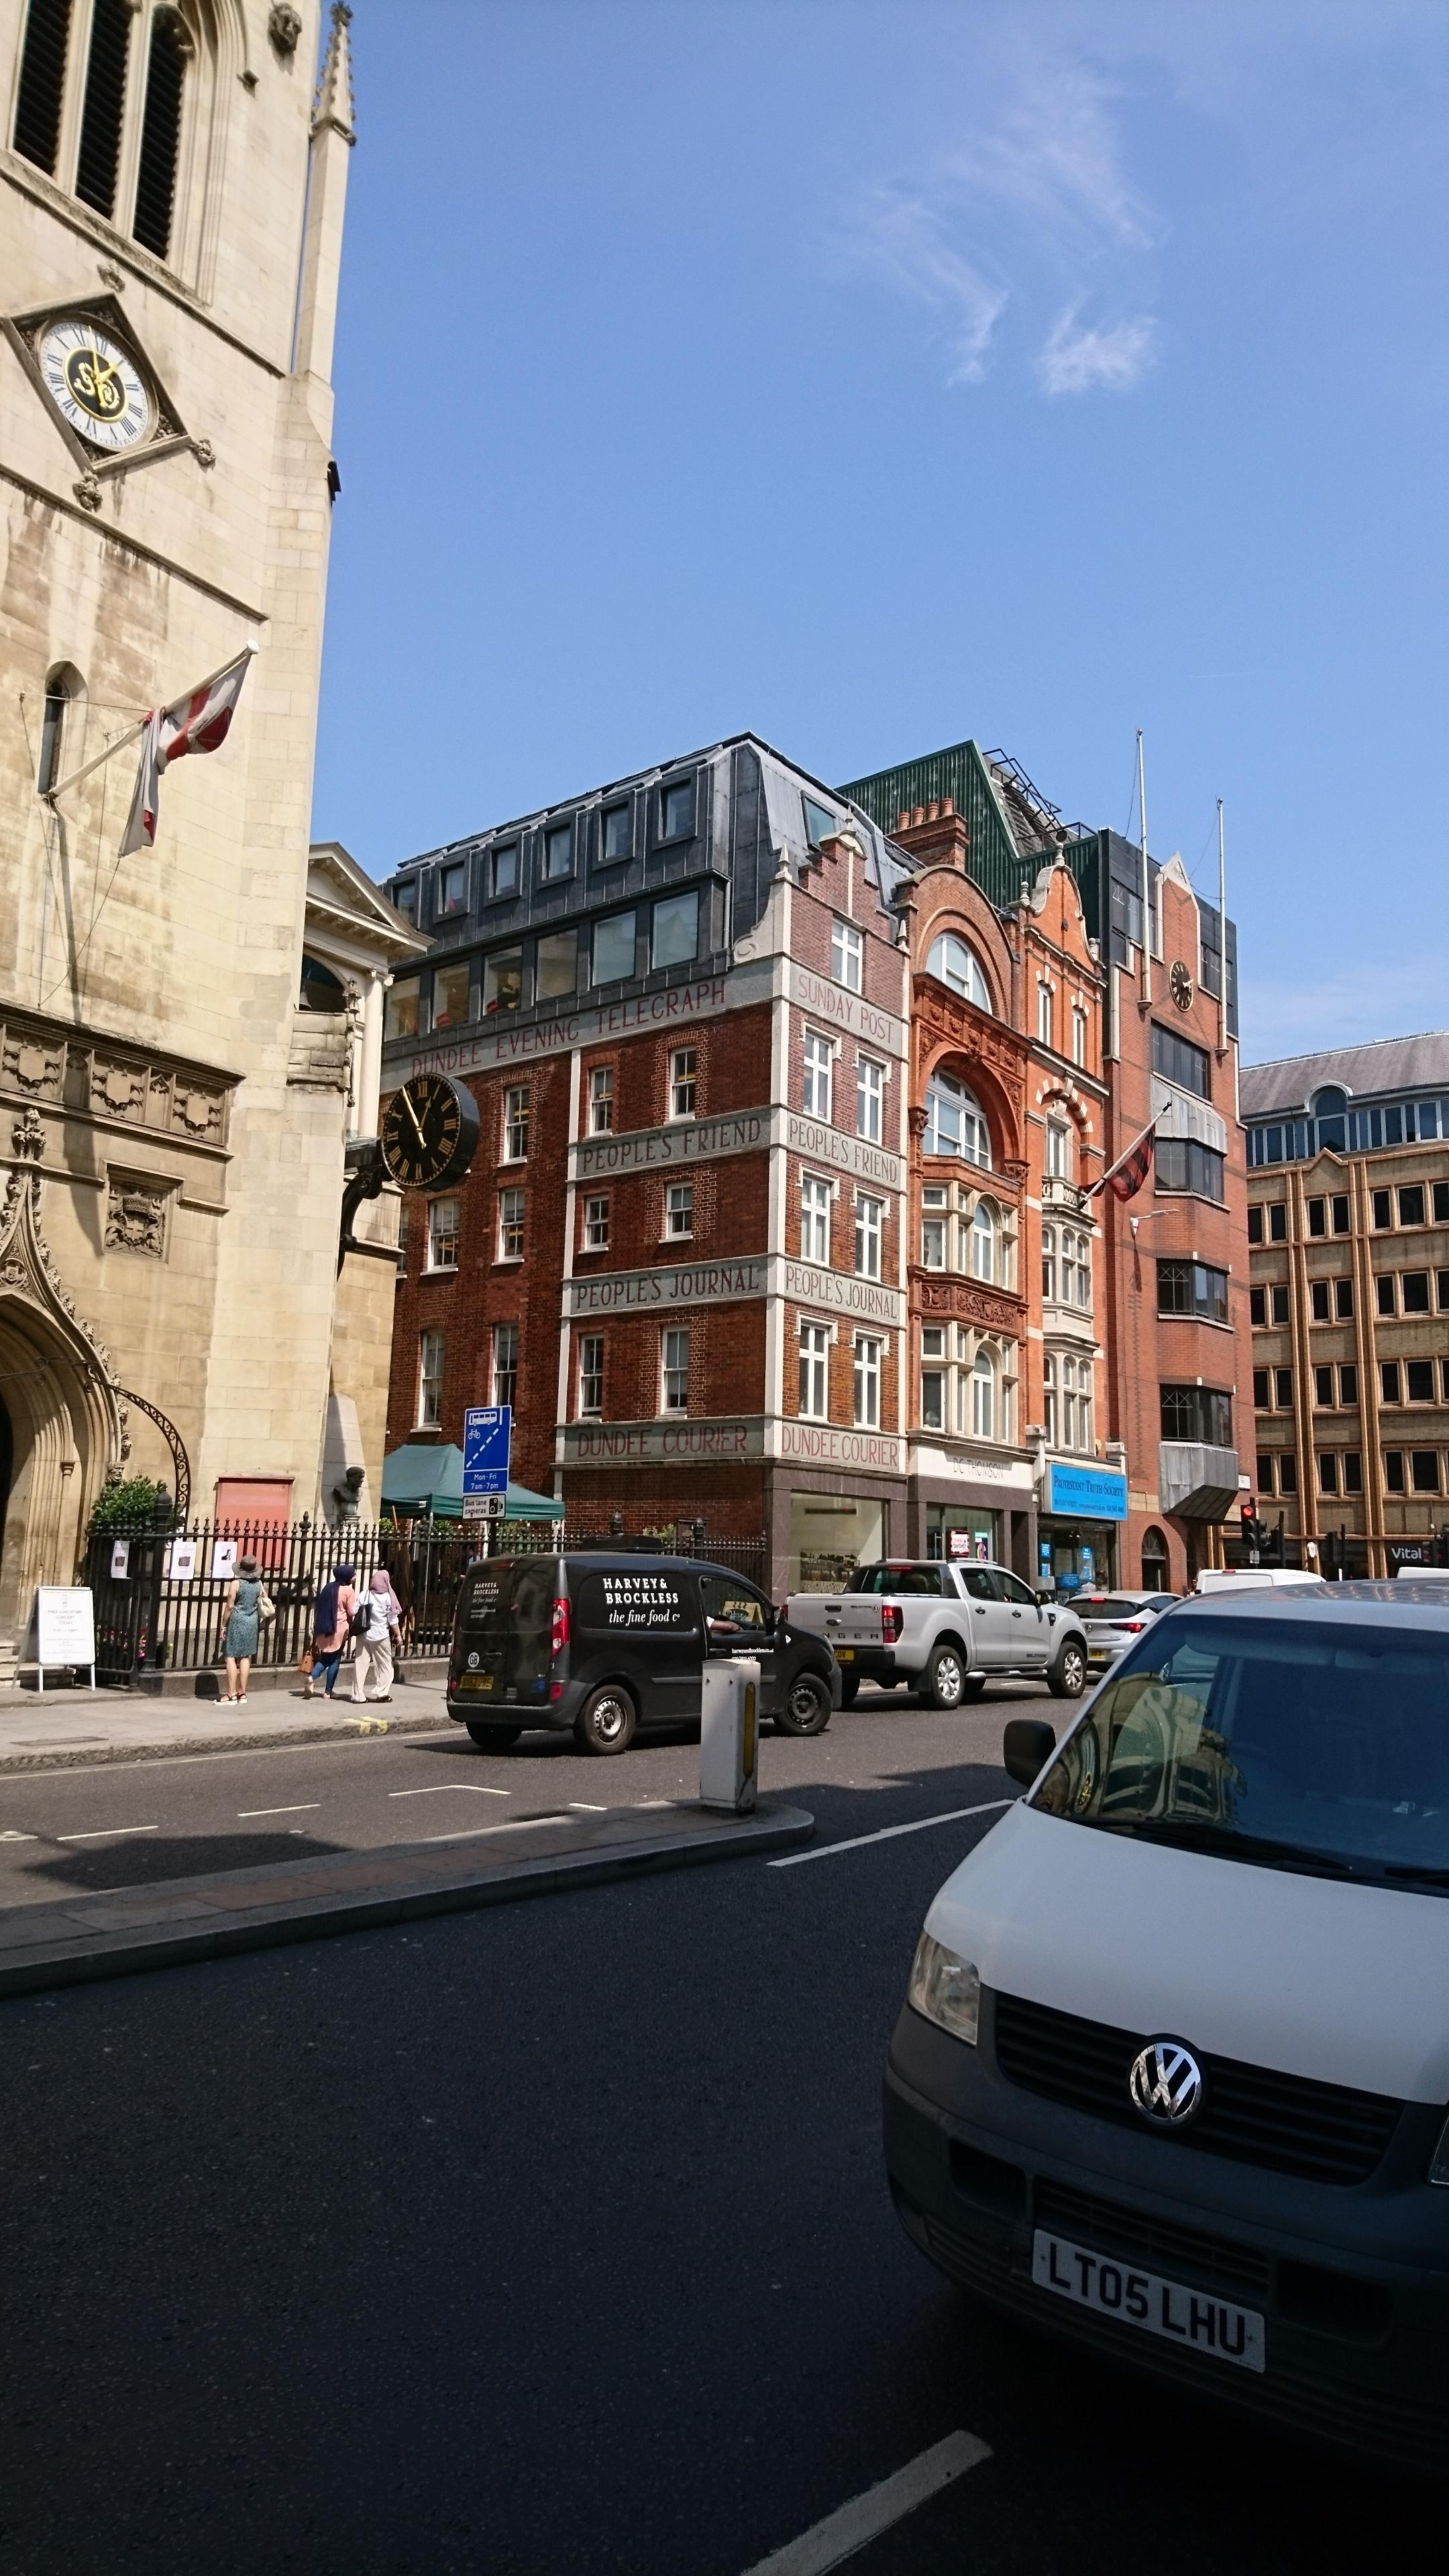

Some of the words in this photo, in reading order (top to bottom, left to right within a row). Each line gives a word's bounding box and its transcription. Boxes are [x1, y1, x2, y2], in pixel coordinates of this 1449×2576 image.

[412, 1042, 482, 1076] DUNDEE
[496, 1018, 580, 1059] EVENING
[596, 979, 725, 1034] TELEGRAPH
[798, 973, 853, 1023] SUNDAY
[861, 1008, 894, 1043] POST
[583, 1132, 672, 1172] PEOPLE'S
[684, 1118, 761, 1152] FRIEND
[790, 1117, 849, 1163] PEOPLE'S
[854, 1144, 898, 1183] FRIEND
[577, 1273, 661, 1309] PEOPLE'S
[669, 1265, 759, 1299] JOURNAL
[786, 1264, 843, 1304] PEOPLE'S
[846, 1285, 898, 1320] JOURNAL
[578, 1429, 651, 1457] DUNDEE
[663, 1425, 747, 1454] COURIER
[782, 1426, 839, 1459] DUNDEE
[842, 1436, 898, 1467] COURIER
[953, 1457, 963, 1474] DC
[967, 1459, 1004, 1479] THOMSON
[605, 1593, 679, 1604] BROCKLESS
[609, 1609, 625, 1623] the
[625, 1609, 646, 1626] fine
[647, 1609, 670, 1626] food
[470, 1654, 478, 1664] GB
[1050, 2242, 1148, 2319] LT05
[1163, 2286, 1244, 2356] LHU
